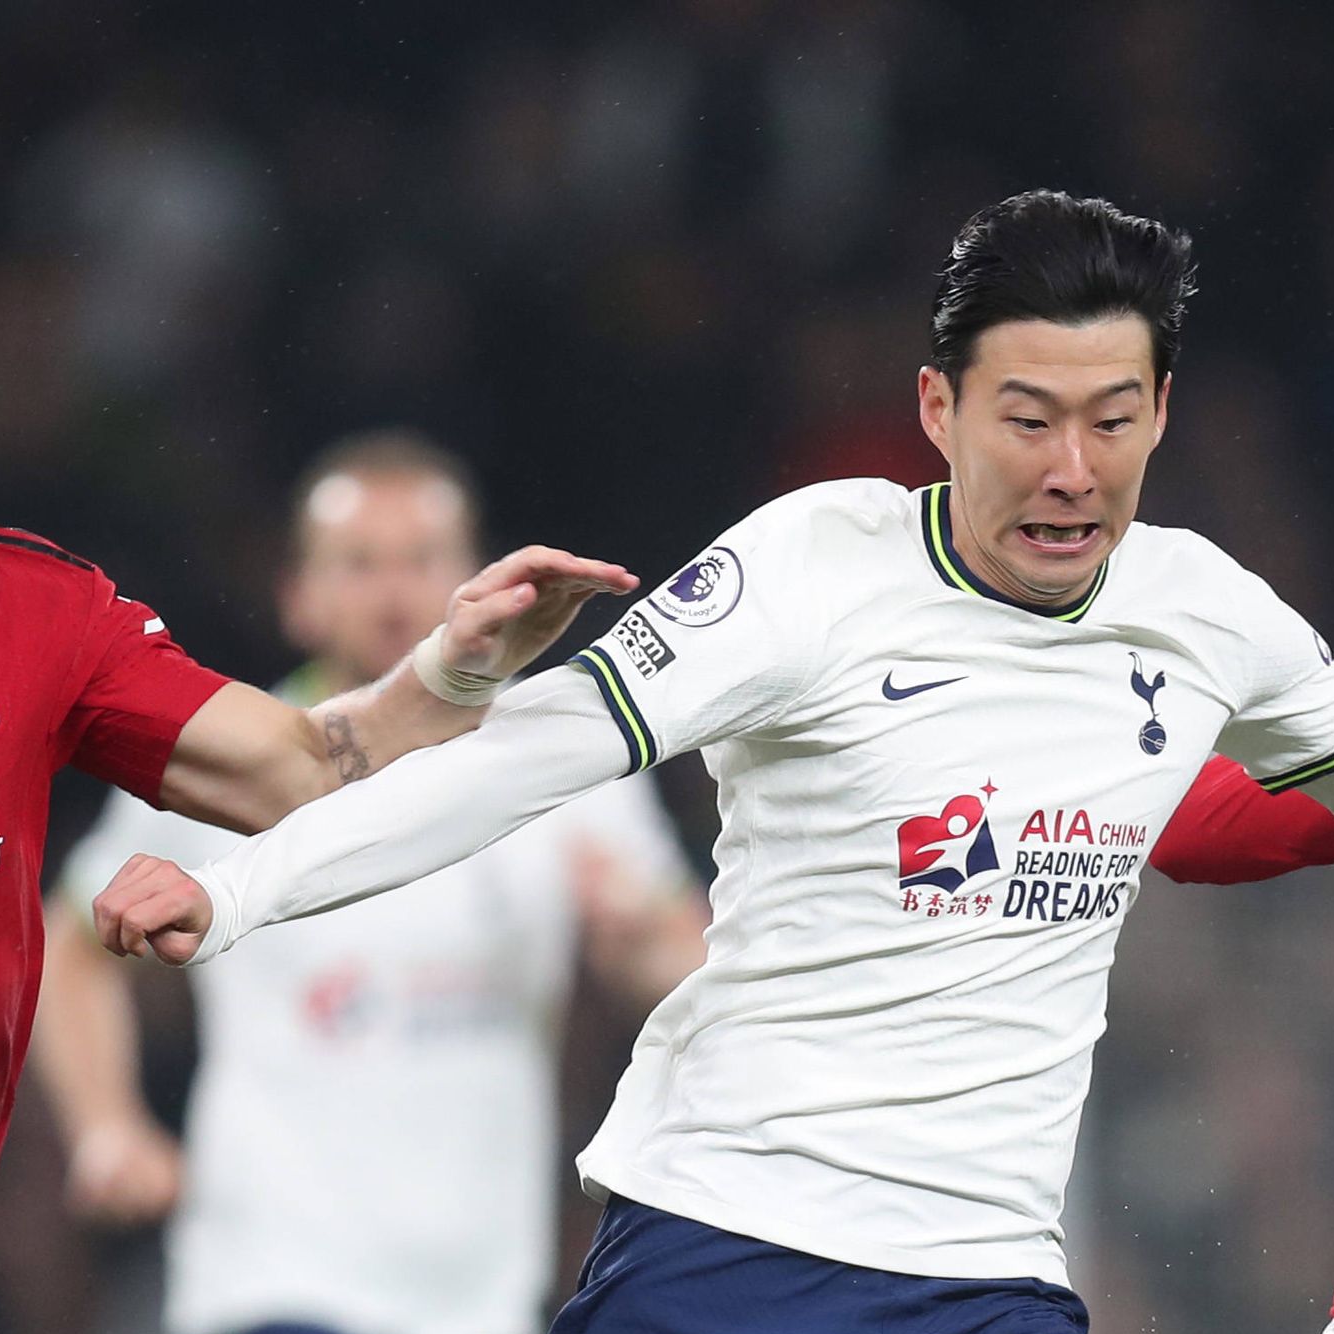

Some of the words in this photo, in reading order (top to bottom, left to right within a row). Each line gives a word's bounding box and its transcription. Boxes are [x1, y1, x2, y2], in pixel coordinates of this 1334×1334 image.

[688, 602, 719, 618] League
[1019, 810, 1094, 844] AIA
[1099, 823, 1147, 847] CHINA
[1014, 851, 1102, 878] READING
[1106, 854, 1138, 880] FOR
[898, 888, 994, 919] 书香筑梦
[1003, 879, 1127, 922] DREAMS
